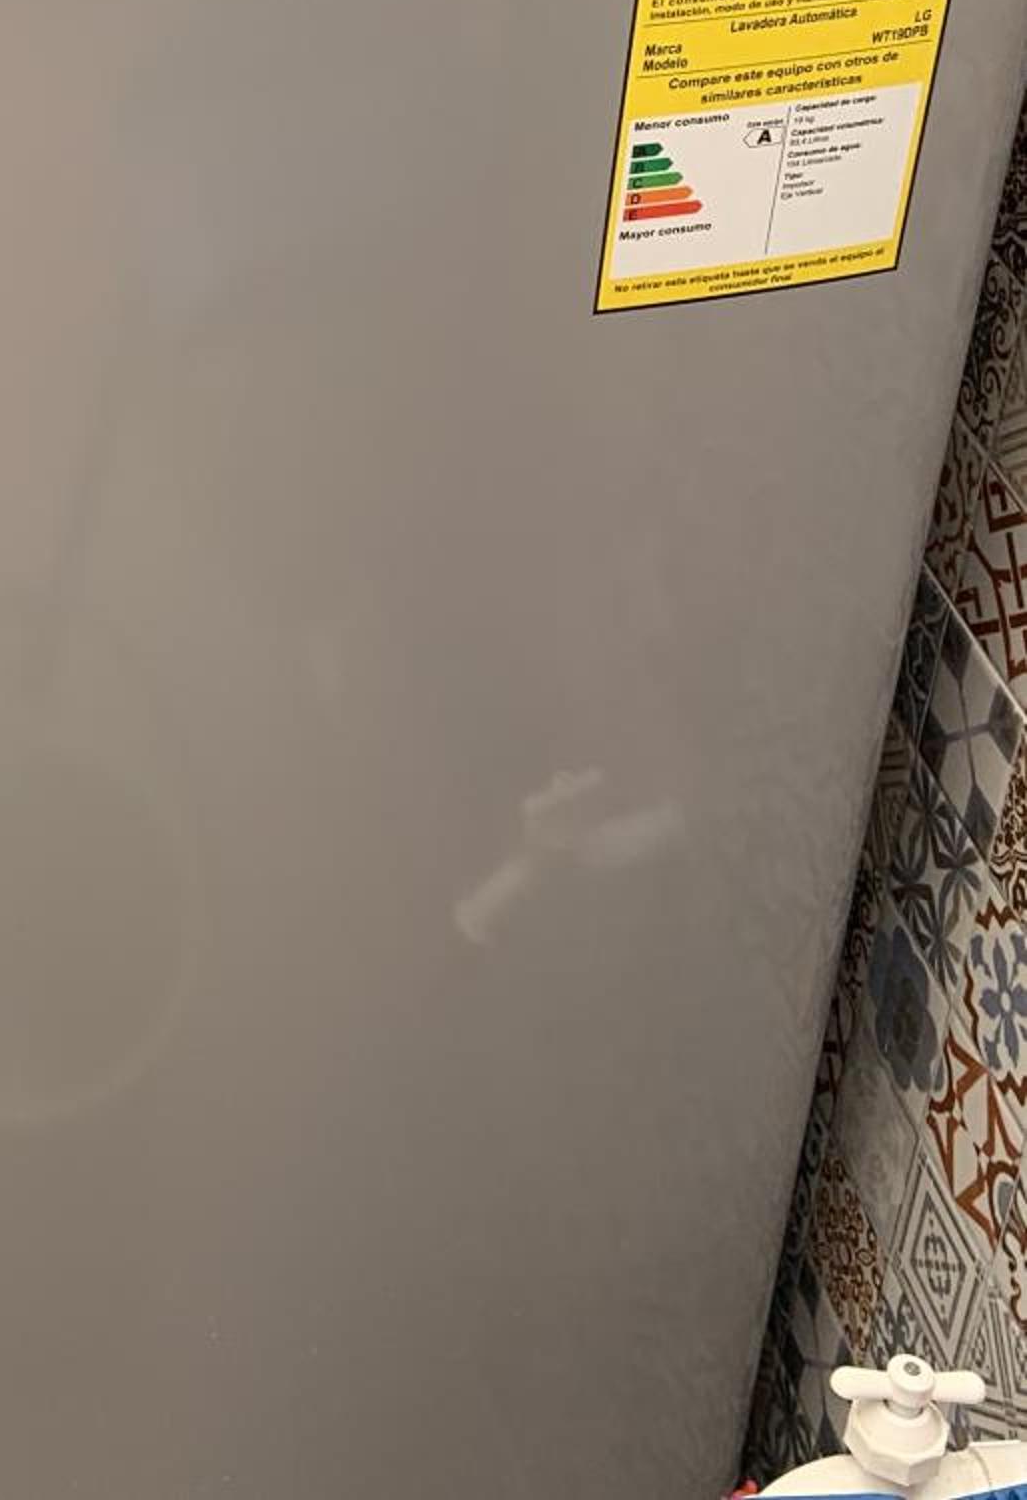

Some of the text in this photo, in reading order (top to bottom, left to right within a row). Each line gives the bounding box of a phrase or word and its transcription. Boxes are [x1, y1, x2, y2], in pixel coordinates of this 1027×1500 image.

[714, 2, 746, 14] modo
[748, 0, 762, 9] de
[730, 6, 858, 33] Lavadora Automática
[644, 8, 933, 57] Marca LG
[642, 57, 688, 72] Modelo
[668, 51, 900, 91] Compare este equipo con otros de
[700, 88, 762, 105] similares
[634, 112, 731, 132] Menor consumo
[756, 129, 773, 146] A
[618, 222, 713, 242] Mayor consumo
[614, 283, 629, 293] No
[689, 271, 730, 284] etiqueta
[732, 266, 760, 279] hasta
[762, 265, 781, 275] que
[783, 262, 795, 271] se
[798, 257, 827, 268] venda
[840, 249, 874, 262] equipo
